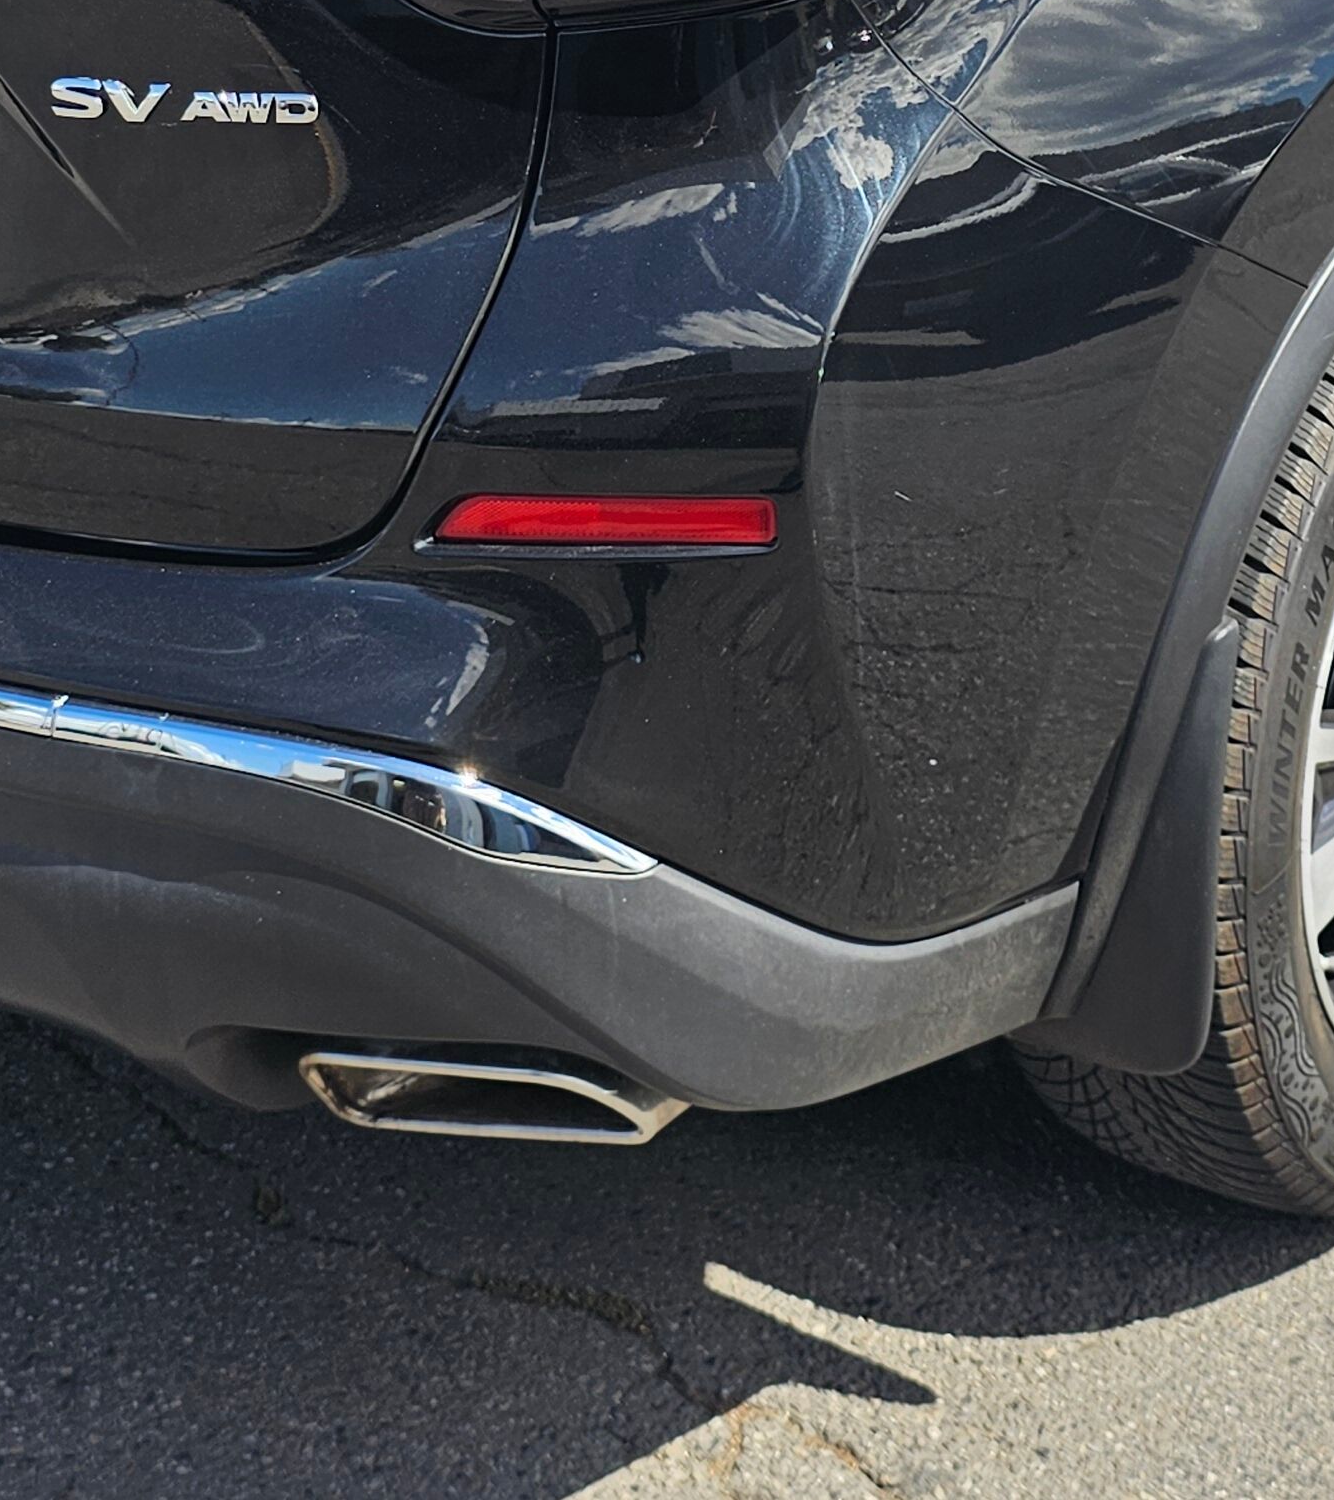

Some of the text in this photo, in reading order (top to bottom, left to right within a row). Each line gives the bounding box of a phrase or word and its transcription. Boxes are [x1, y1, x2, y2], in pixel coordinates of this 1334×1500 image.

[51, 76, 319, 123] SV AWD
[1269, 642, 1310, 847] WINTER
